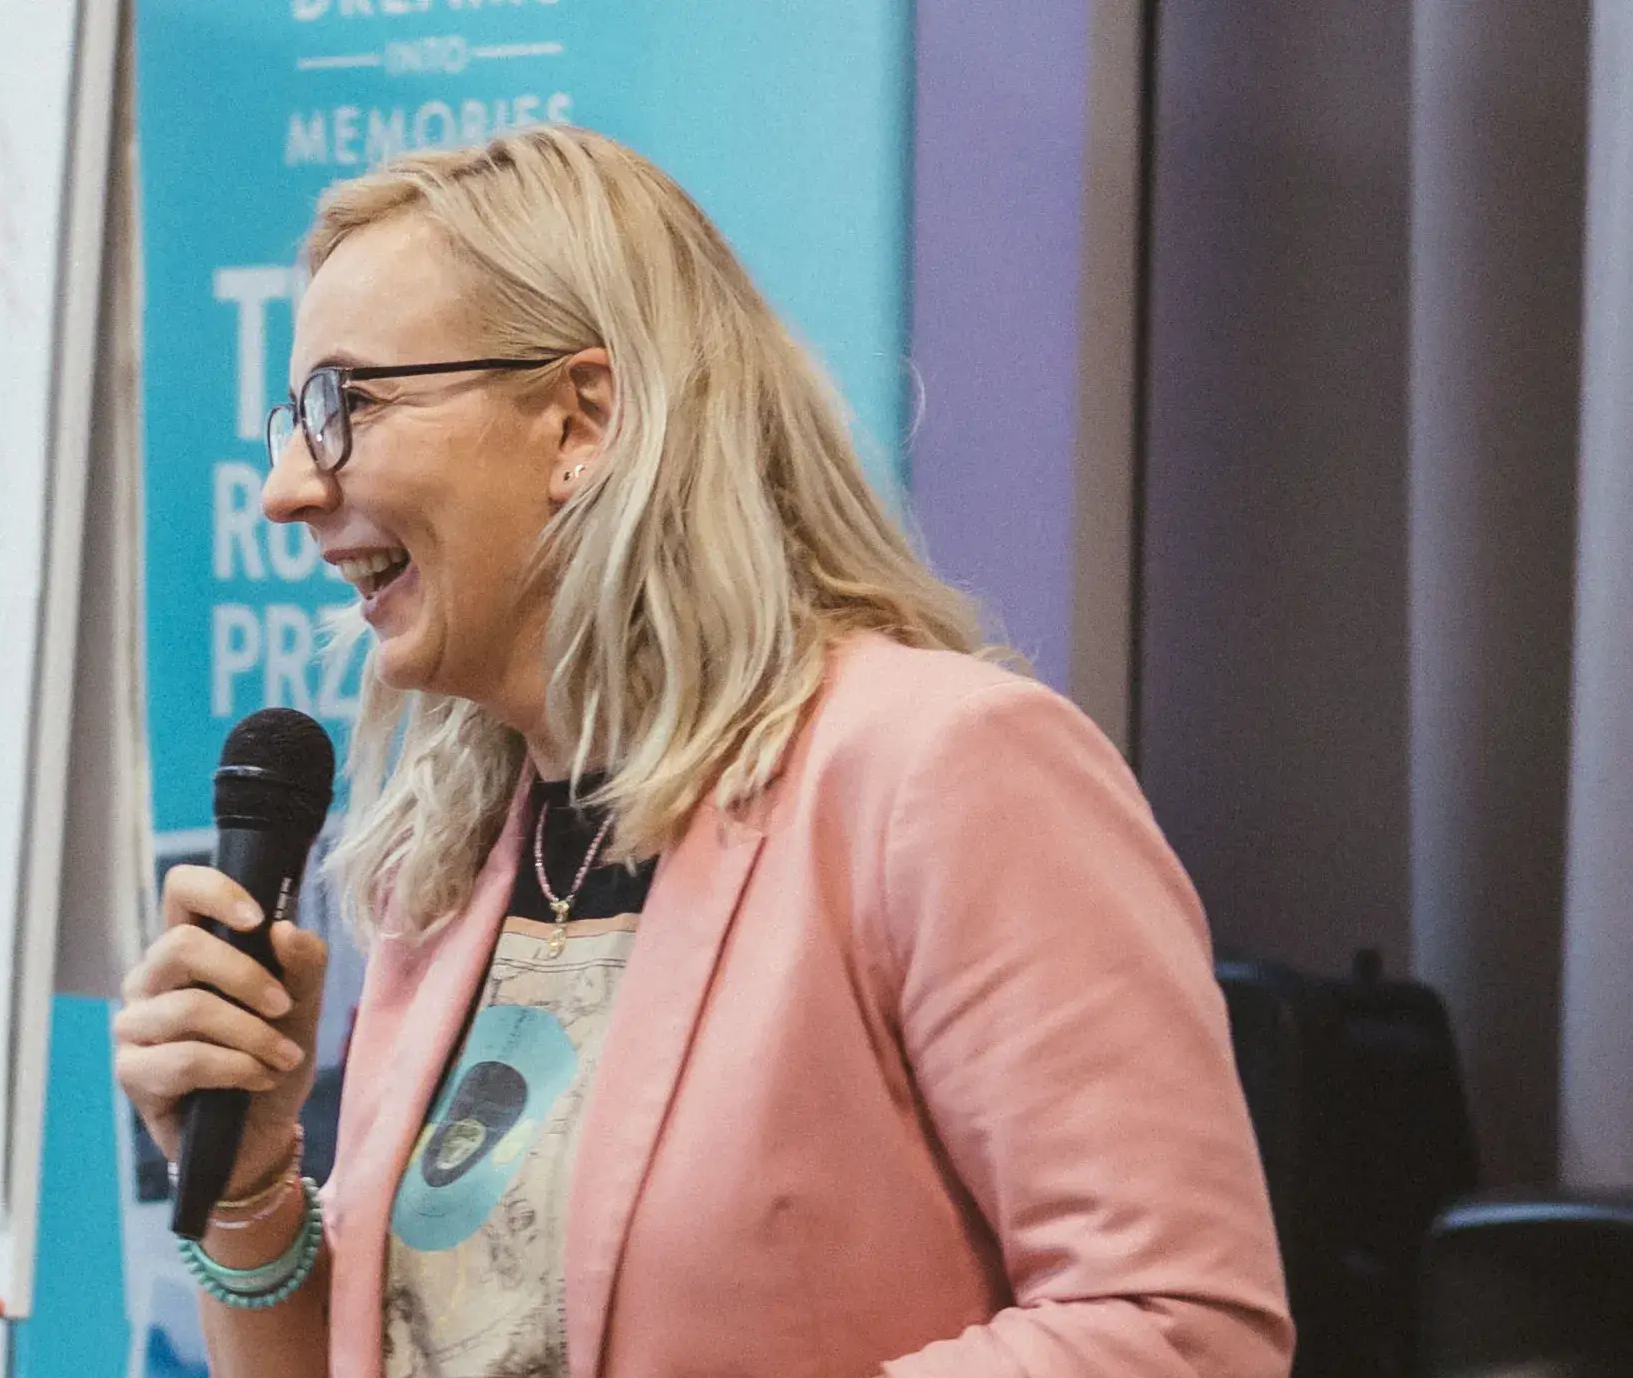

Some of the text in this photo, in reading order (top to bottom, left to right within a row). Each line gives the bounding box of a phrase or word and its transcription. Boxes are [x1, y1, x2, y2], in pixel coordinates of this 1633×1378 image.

[385, 35, 469, 75] INTO
[285, 92, 574, 166] MEMORIES
[212, 266, 306, 437] T
